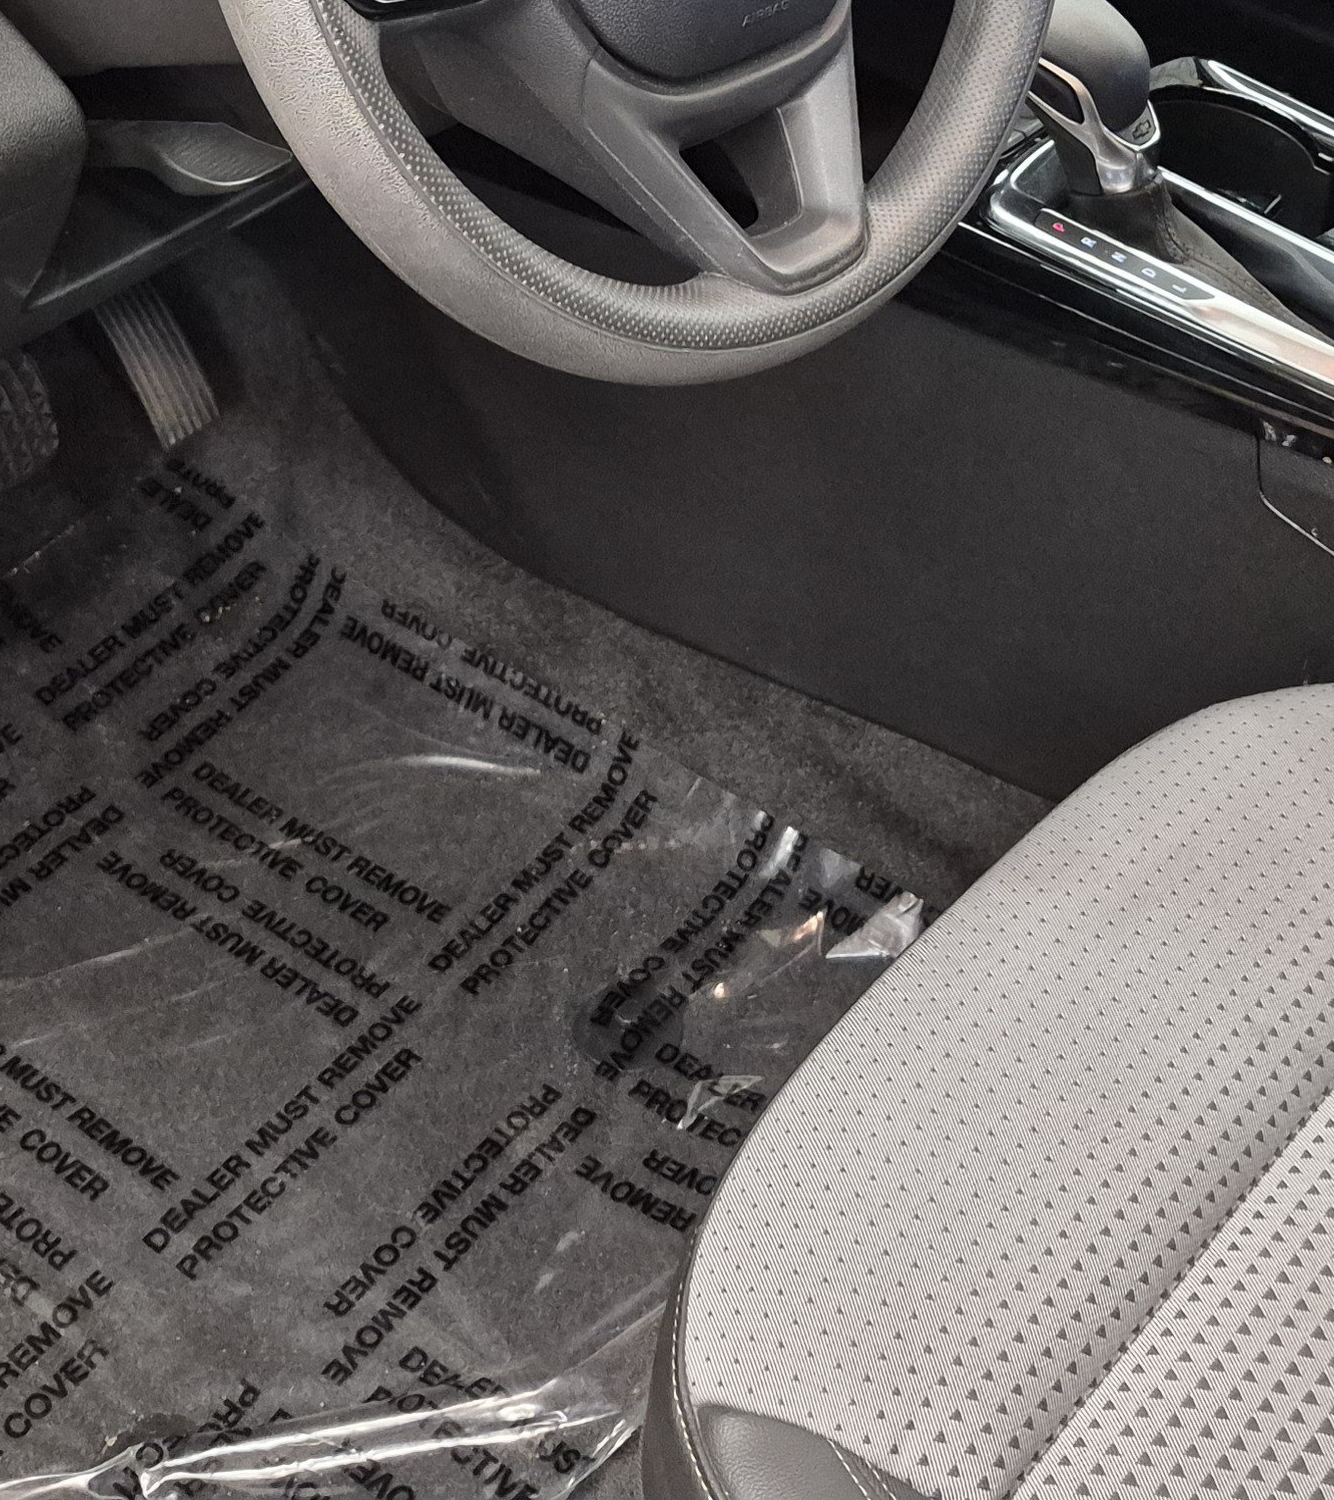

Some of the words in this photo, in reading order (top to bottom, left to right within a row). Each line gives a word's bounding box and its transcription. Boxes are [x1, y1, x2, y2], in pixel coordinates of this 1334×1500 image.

[288, 567, 346, 659] DEALER
[340, 615, 430, 682] REMOVE
[381, 600, 453, 648] COVER
[228, 657, 291, 712] MUST
[429, 674, 495, 721] MUST
[460, 646, 603, 736] PROTECTIVE
[135, 709, 233, 789] REMOVE
[498, 705, 592, 774] DEALER
[29, 804, 125, 882] DEALER
[96, 851, 198, 921] REMOVE
[159, 849, 241, 903] COVER
[161, 786, 304, 881] PROTECTIVE
[305, 875, 390, 932] COVER
[192, 761, 284, 824] DEALER
[278, 817, 352, 863] MUST
[347, 855, 452, 924] REMOVE
[428, 893, 520, 971] DEALER
[511, 832, 574, 893] MUST
[568, 731, 640, 834] REMOVE
[659, 814, 775, 952] PROTECTIVE
[460, 868, 594, 996] PROTECTIVE
[587, 789, 659, 869] COVER
[190, 915, 269, 967] MUST
[241, 900, 391, 999] PROTECTIVE
[259, 956, 360, 1028] DEALER
[0, 1054, 77, 1111] MUST
[67, 1107, 180, 1190] REMOVE
[19, 1127, 110, 1201] COVER
[141, 1154, 252, 1254] DEALER
[244, 1084, 319, 1156] MUST
[316, 994, 422, 1090] REMOVE
[175, 1126, 338, 1281] PROTECTIVE
[334, 1048, 423, 1126] COVER
[414, 1083, 563, 1225] PROTECTIVE
[498, 1105, 598, 1195] DEALER
[433, 1193, 509, 1272] MUST
[575, 1155, 697, 1232] REMOVE
[323, 1224, 417, 1318] COVER
[321, 1266, 439, 1386] REMOVE
[3, 1339, 110, 1439] COVER
